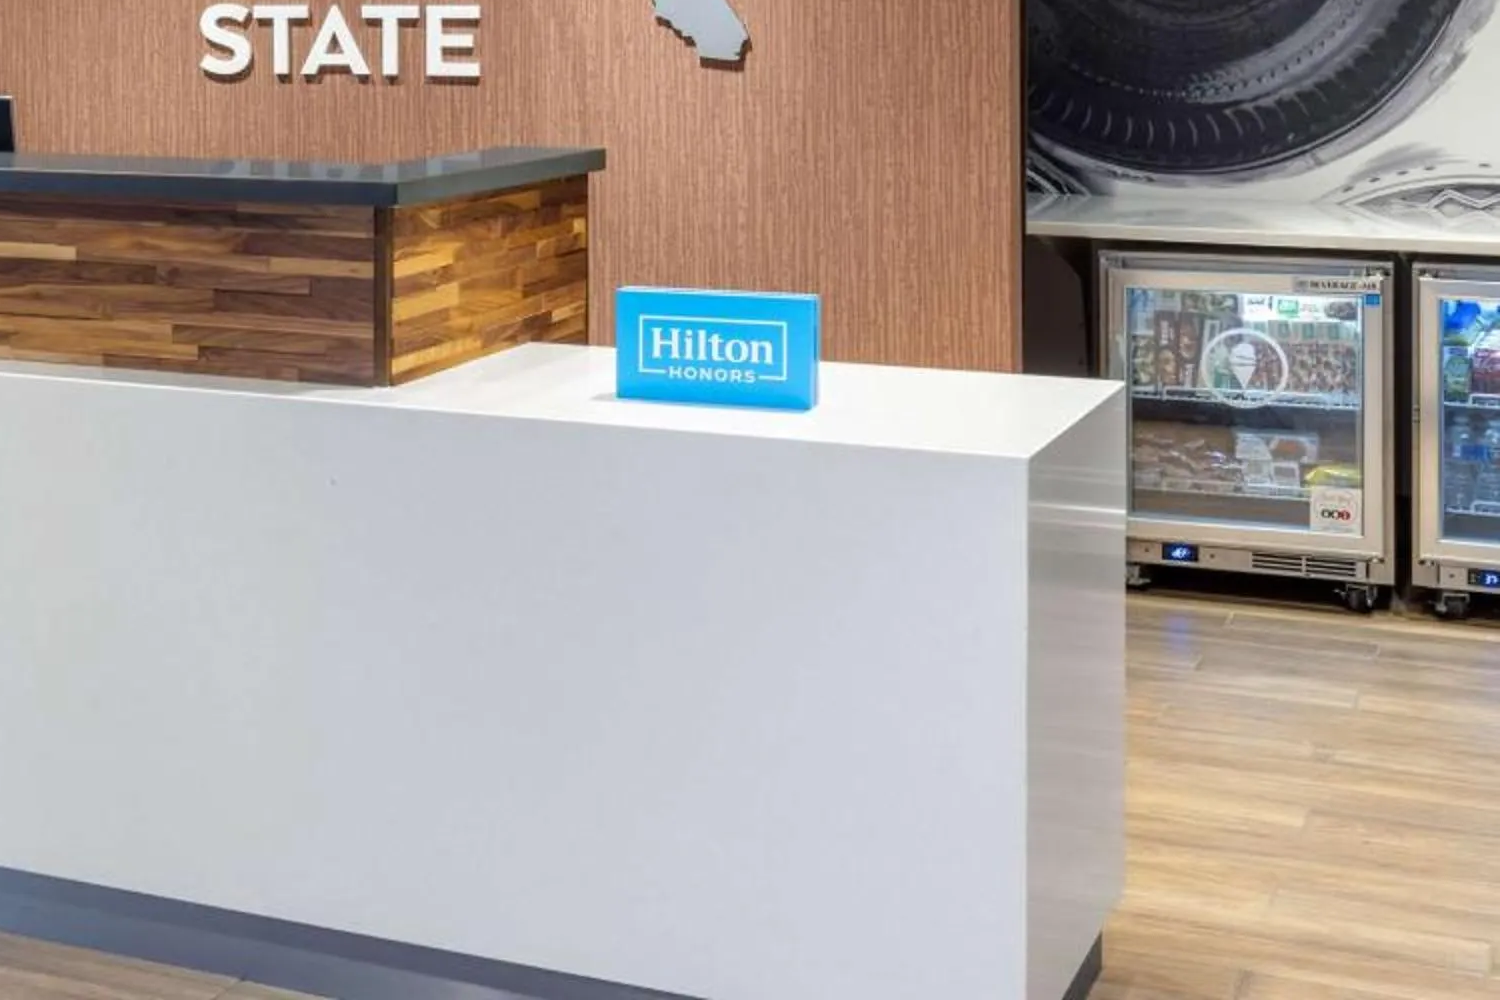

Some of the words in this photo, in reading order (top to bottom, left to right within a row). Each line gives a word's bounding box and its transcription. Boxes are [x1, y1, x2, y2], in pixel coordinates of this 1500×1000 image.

[199, 2, 482, 78] STATE
[650, 326, 774, 366] Hilton
[668, 366, 757, 384] HONORS
